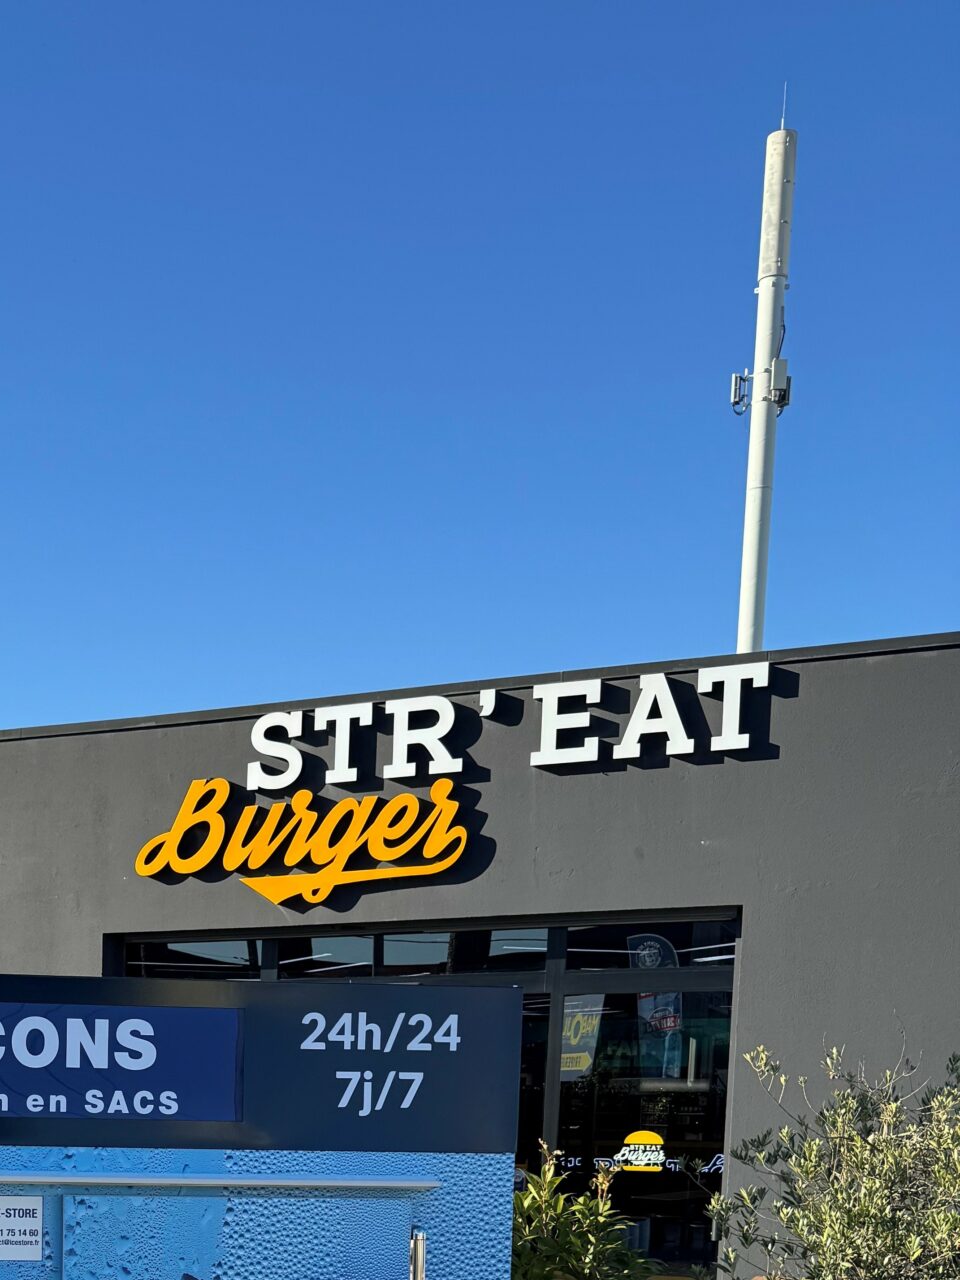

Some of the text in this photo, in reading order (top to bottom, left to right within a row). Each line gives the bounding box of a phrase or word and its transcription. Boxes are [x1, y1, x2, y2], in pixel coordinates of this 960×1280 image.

[136, 778, 467, 904] Burger
[300, 1011, 461, 1053] 24h/24
[26, 1095, 68, 1113] en
[85, 1089, 180, 1115] SACS
[336, 1071, 424, 1117] 7j/7
[614, 1146, 667, 1163] Burger
[6, 1229, 16, 1237] 75
[18, 1229, 27, 1237] 14
[28, 1229, 39, 1237] 60
